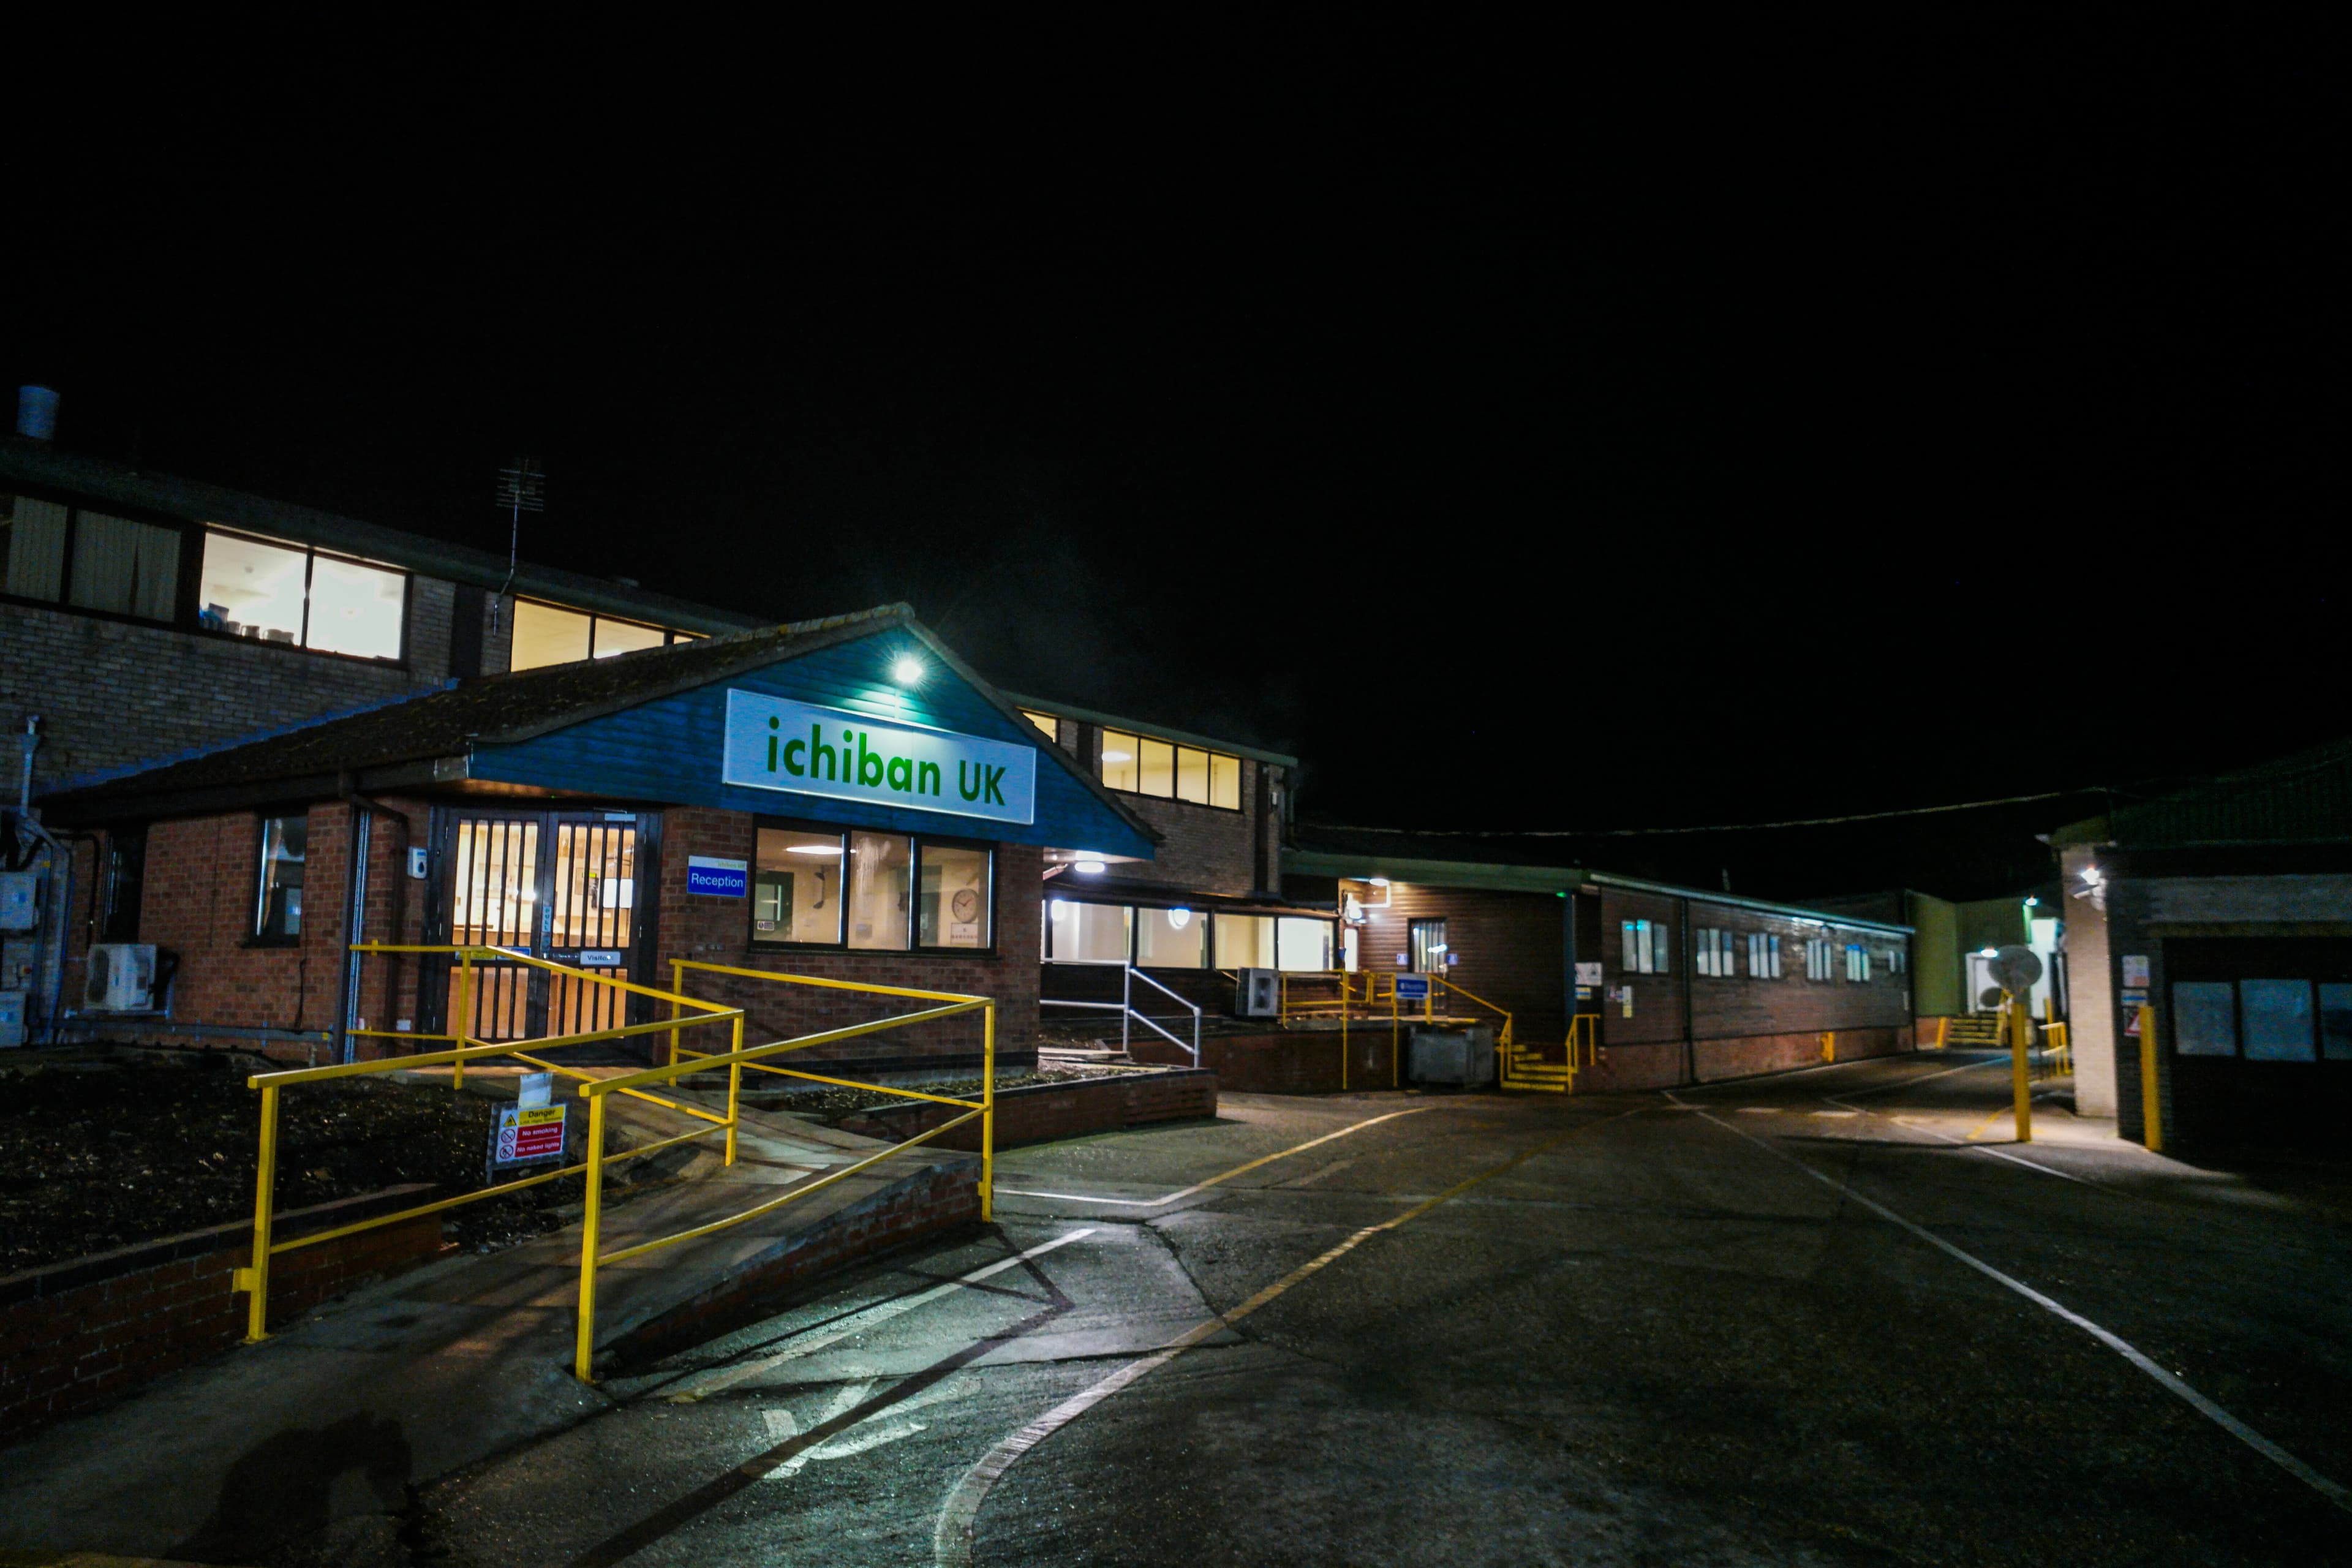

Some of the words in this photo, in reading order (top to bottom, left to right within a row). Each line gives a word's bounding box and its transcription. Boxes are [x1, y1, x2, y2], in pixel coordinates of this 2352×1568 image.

[767, 716, 941, 796] ichiban
[959, 760, 1006, 806] UK
[692, 872, 744, 889] Reception
